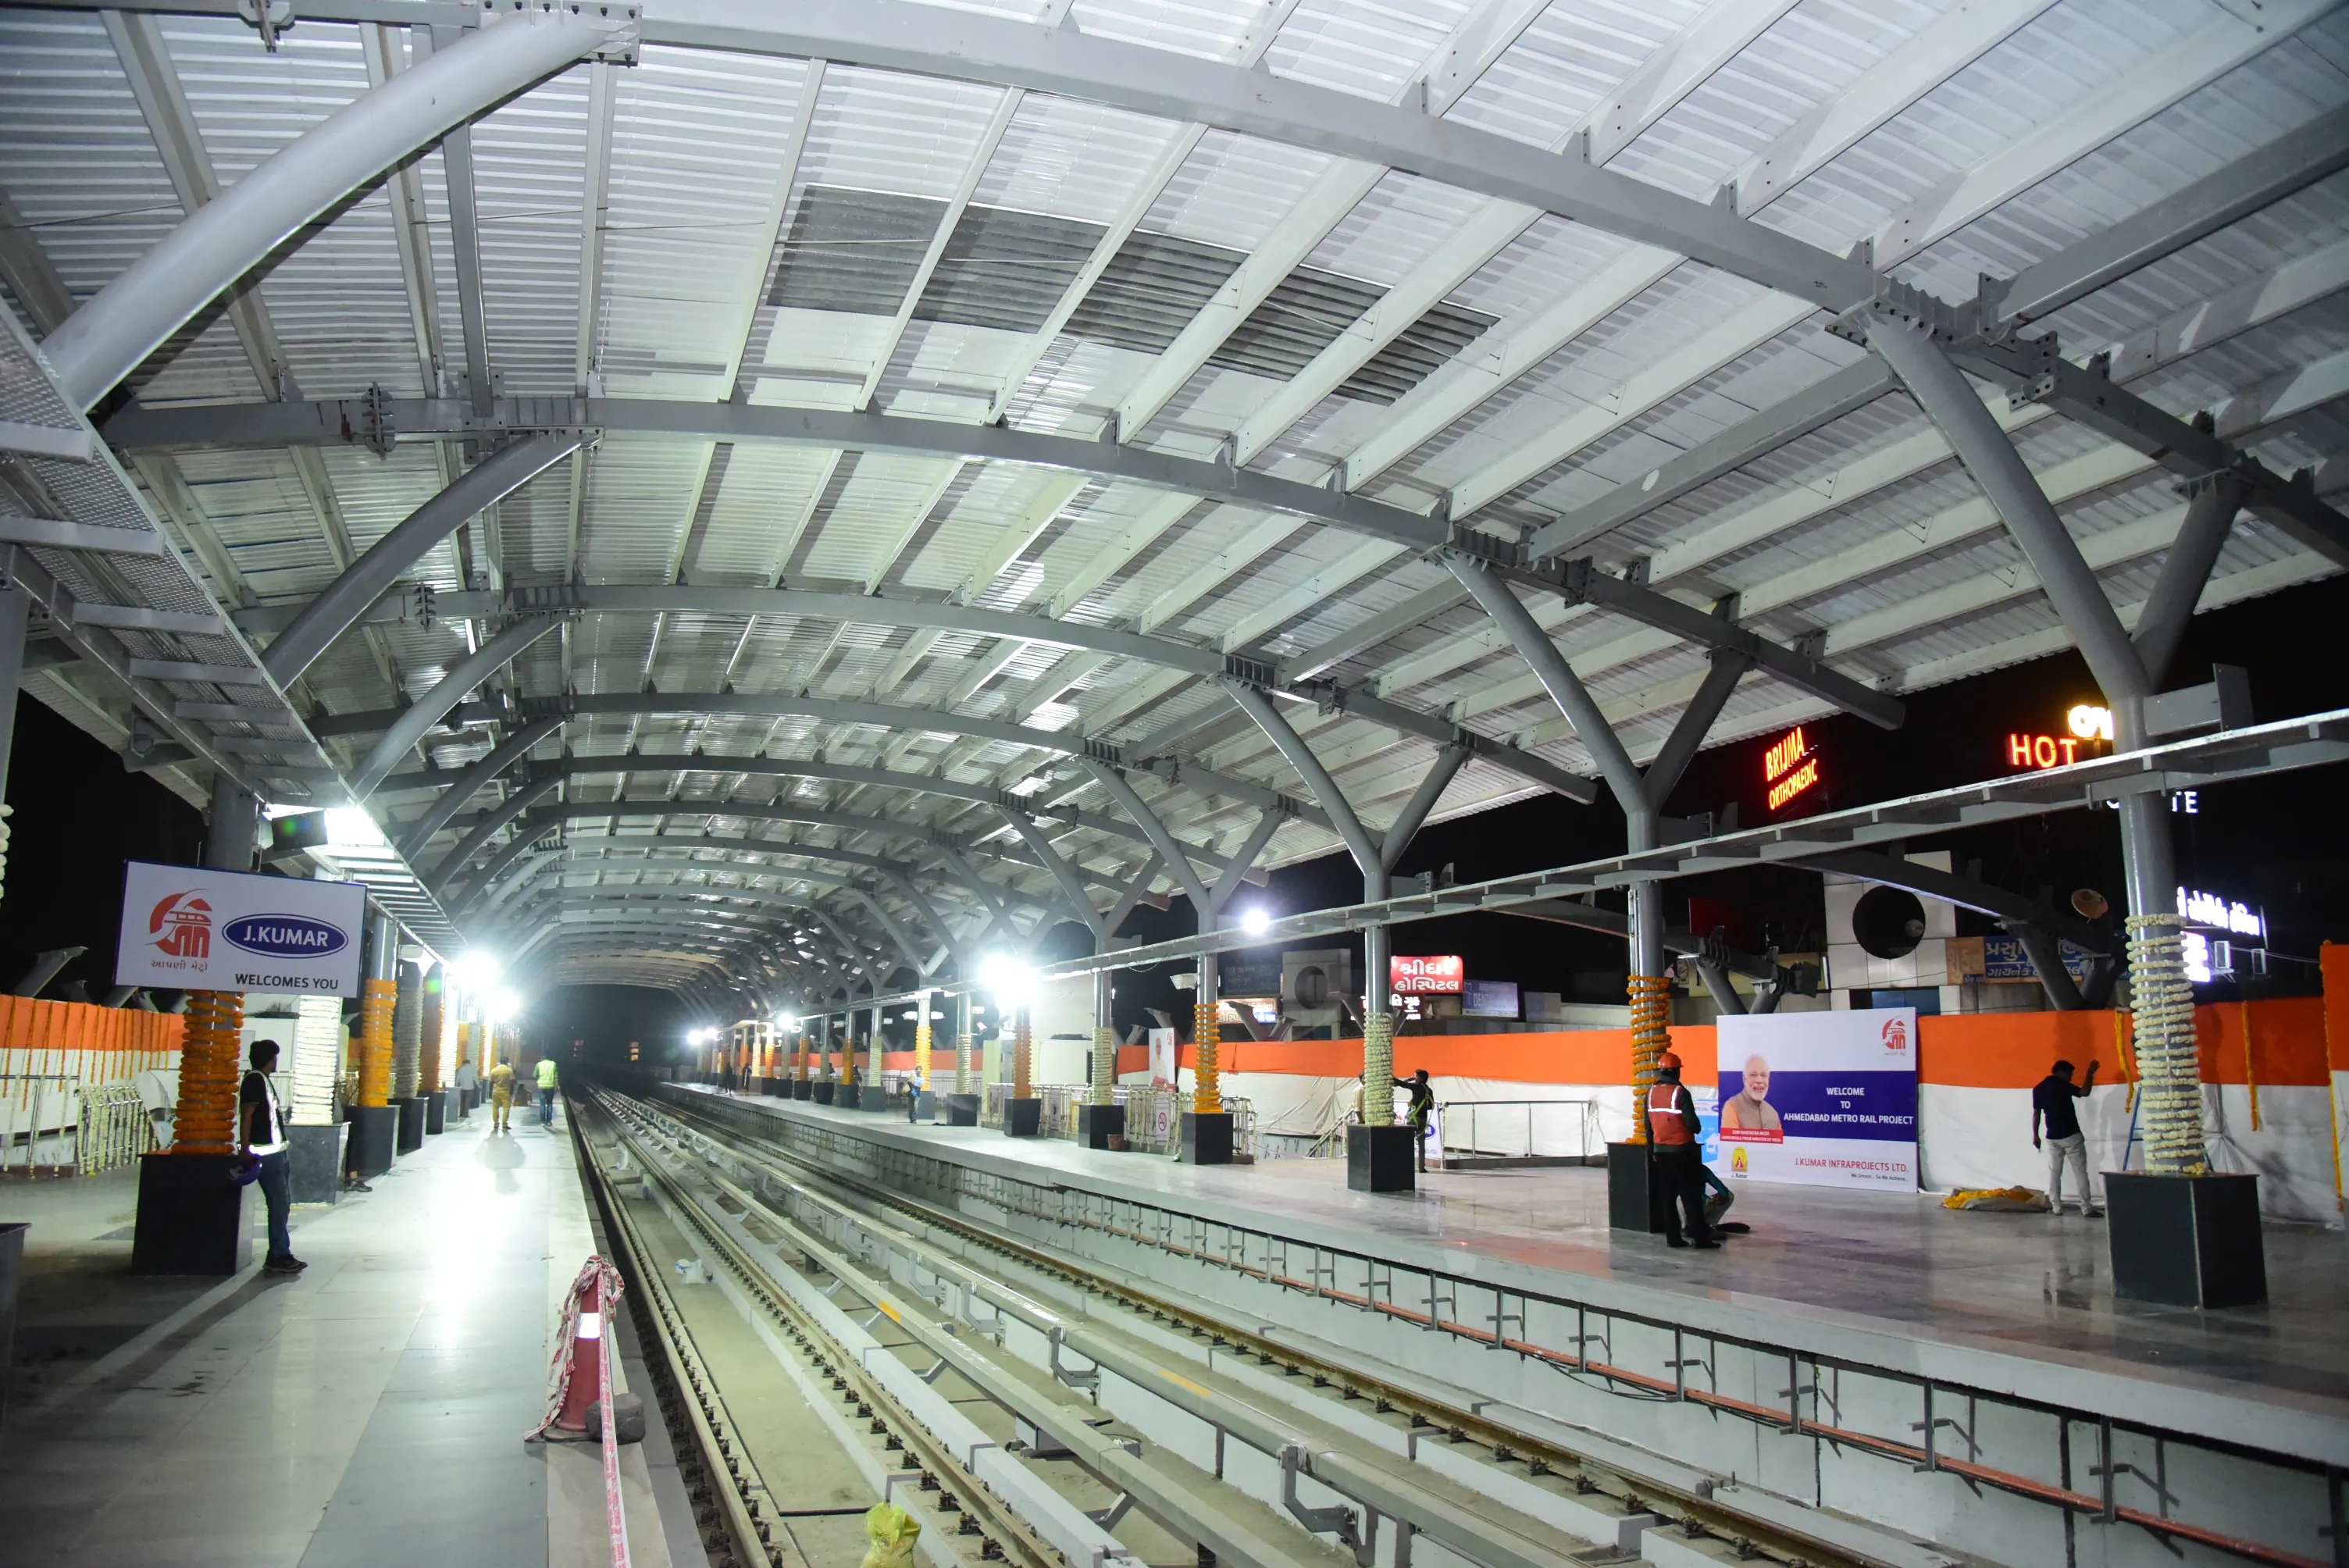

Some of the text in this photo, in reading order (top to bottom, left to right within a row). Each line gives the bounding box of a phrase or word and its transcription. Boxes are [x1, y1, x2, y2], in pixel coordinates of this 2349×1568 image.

[1766, 726, 1805, 782] BRIJMA
[1769, 758, 1818, 811] ORTHOPAEDIC
[244, 925, 329, 947] J.KUMAR
[151, 960, 186, 970] આપણી
[235, 973, 339, 990] WELCOMES YOU
[1394, 976, 1460, 992] હોસ્પિટલ
[1826, 1087, 1865, 1096] WELCOME
[1840, 1100, 1851, 1109] TO
[1784, 1113, 1914, 1124] AHMEDABAD METRO RAIL PROJECT
[1795, 1157, 1909, 1173] J.KUMAR INFRAPROJECTS LTD.
